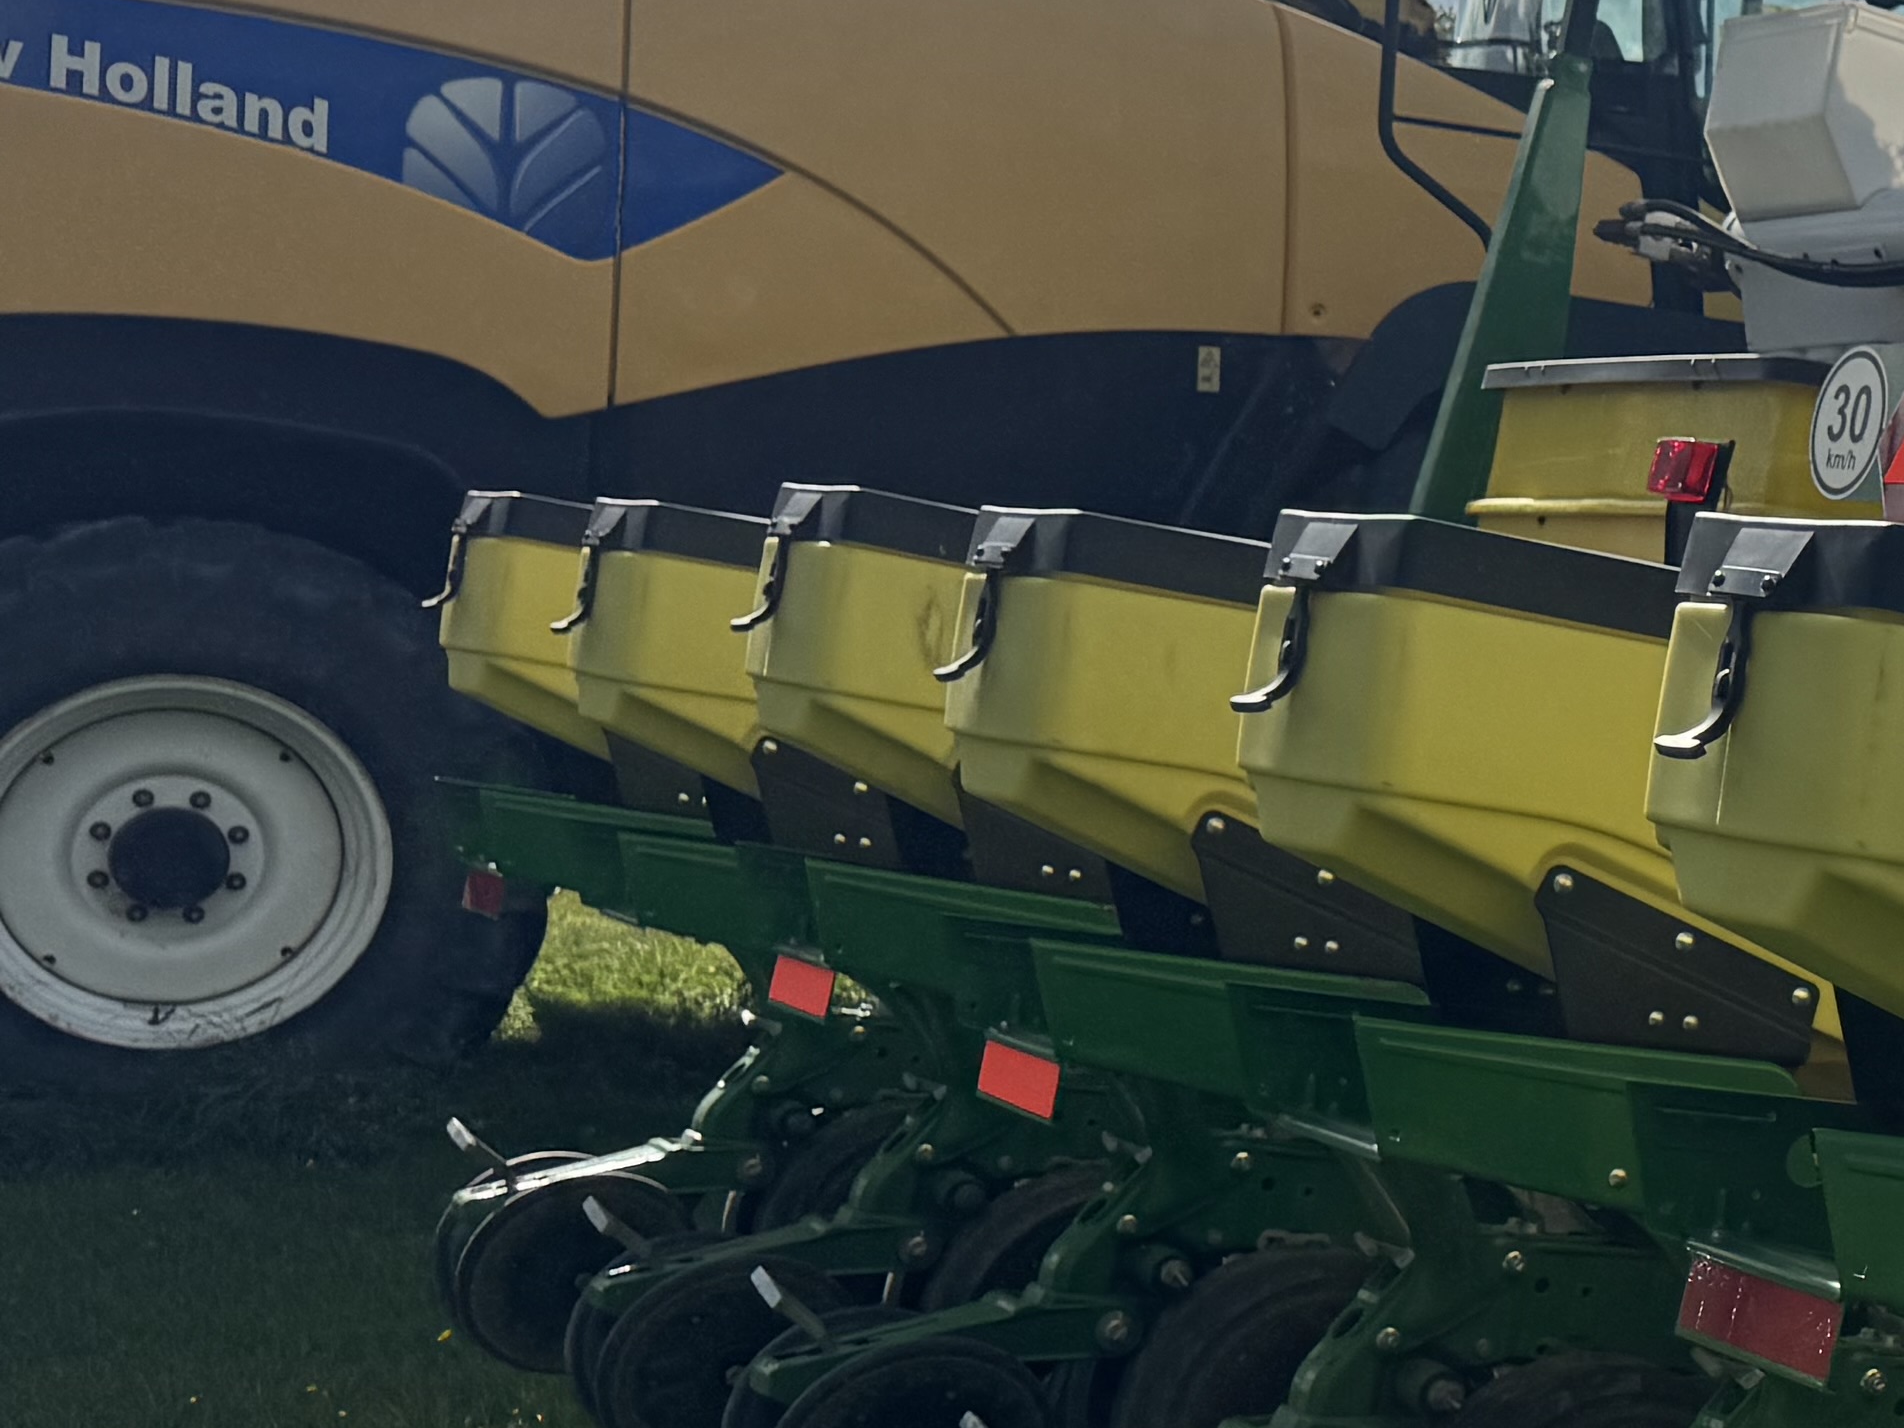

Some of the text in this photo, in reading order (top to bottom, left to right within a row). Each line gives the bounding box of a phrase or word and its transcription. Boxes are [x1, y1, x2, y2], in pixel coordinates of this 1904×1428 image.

[50, 33, 329, 154] Holland
[1827, 384, 1872, 443] 30
[1826, 449, 1856, 470] km/h
